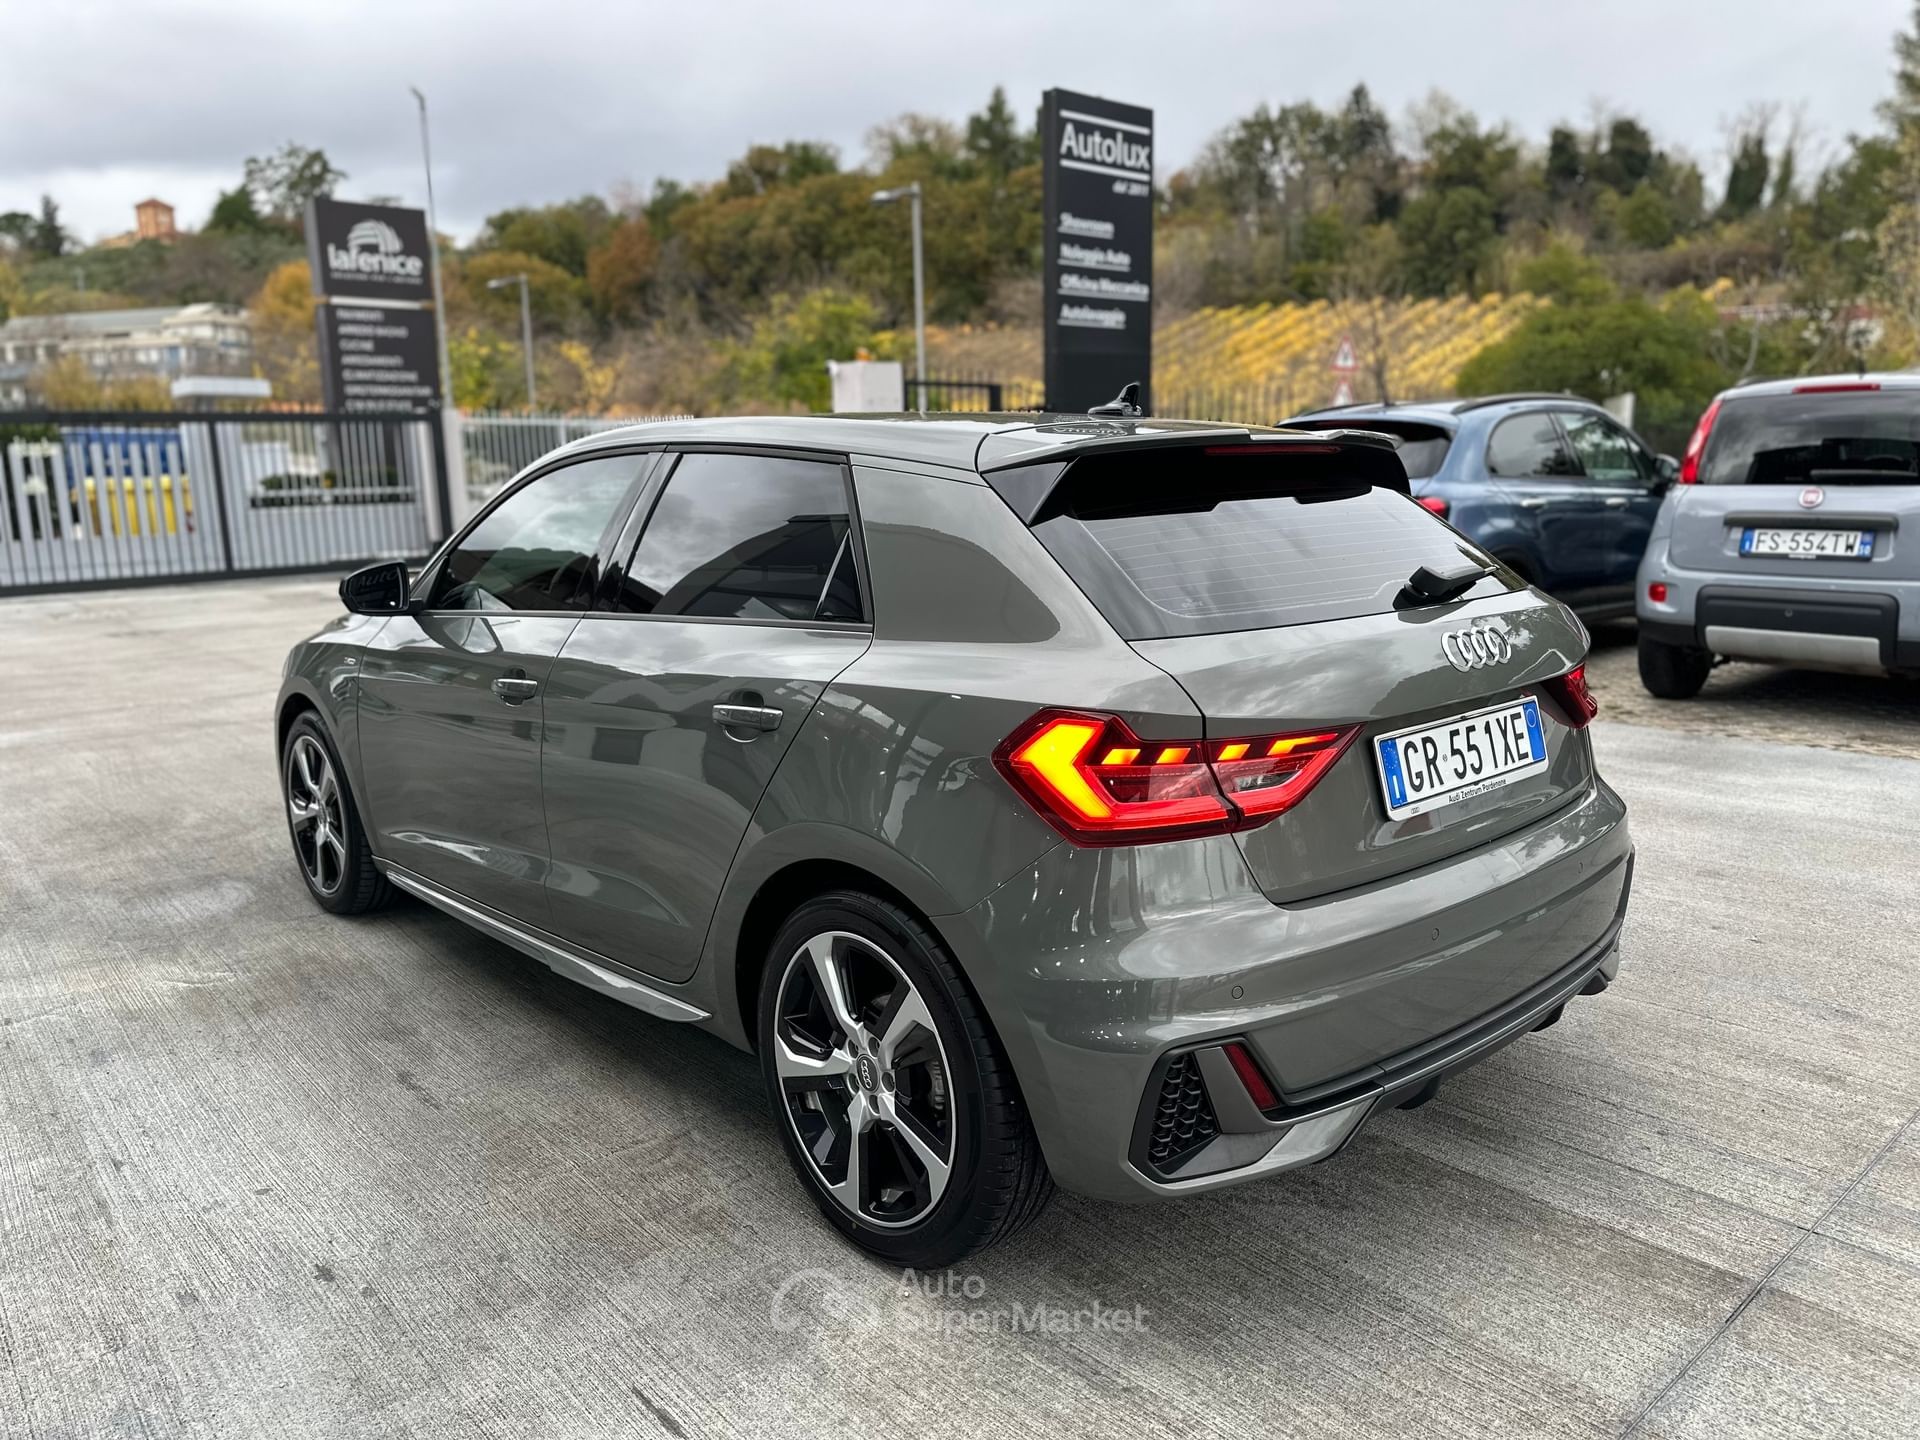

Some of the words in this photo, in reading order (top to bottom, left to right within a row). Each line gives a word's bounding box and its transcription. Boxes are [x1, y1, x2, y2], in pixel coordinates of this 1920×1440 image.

[1060, 122, 1150, 170] Autolux
[1448, 792, 1460, 803] Audi
[1461, 787, 1482, 799] Zentrum
[1482, 779, 1506, 792] Pordenone
